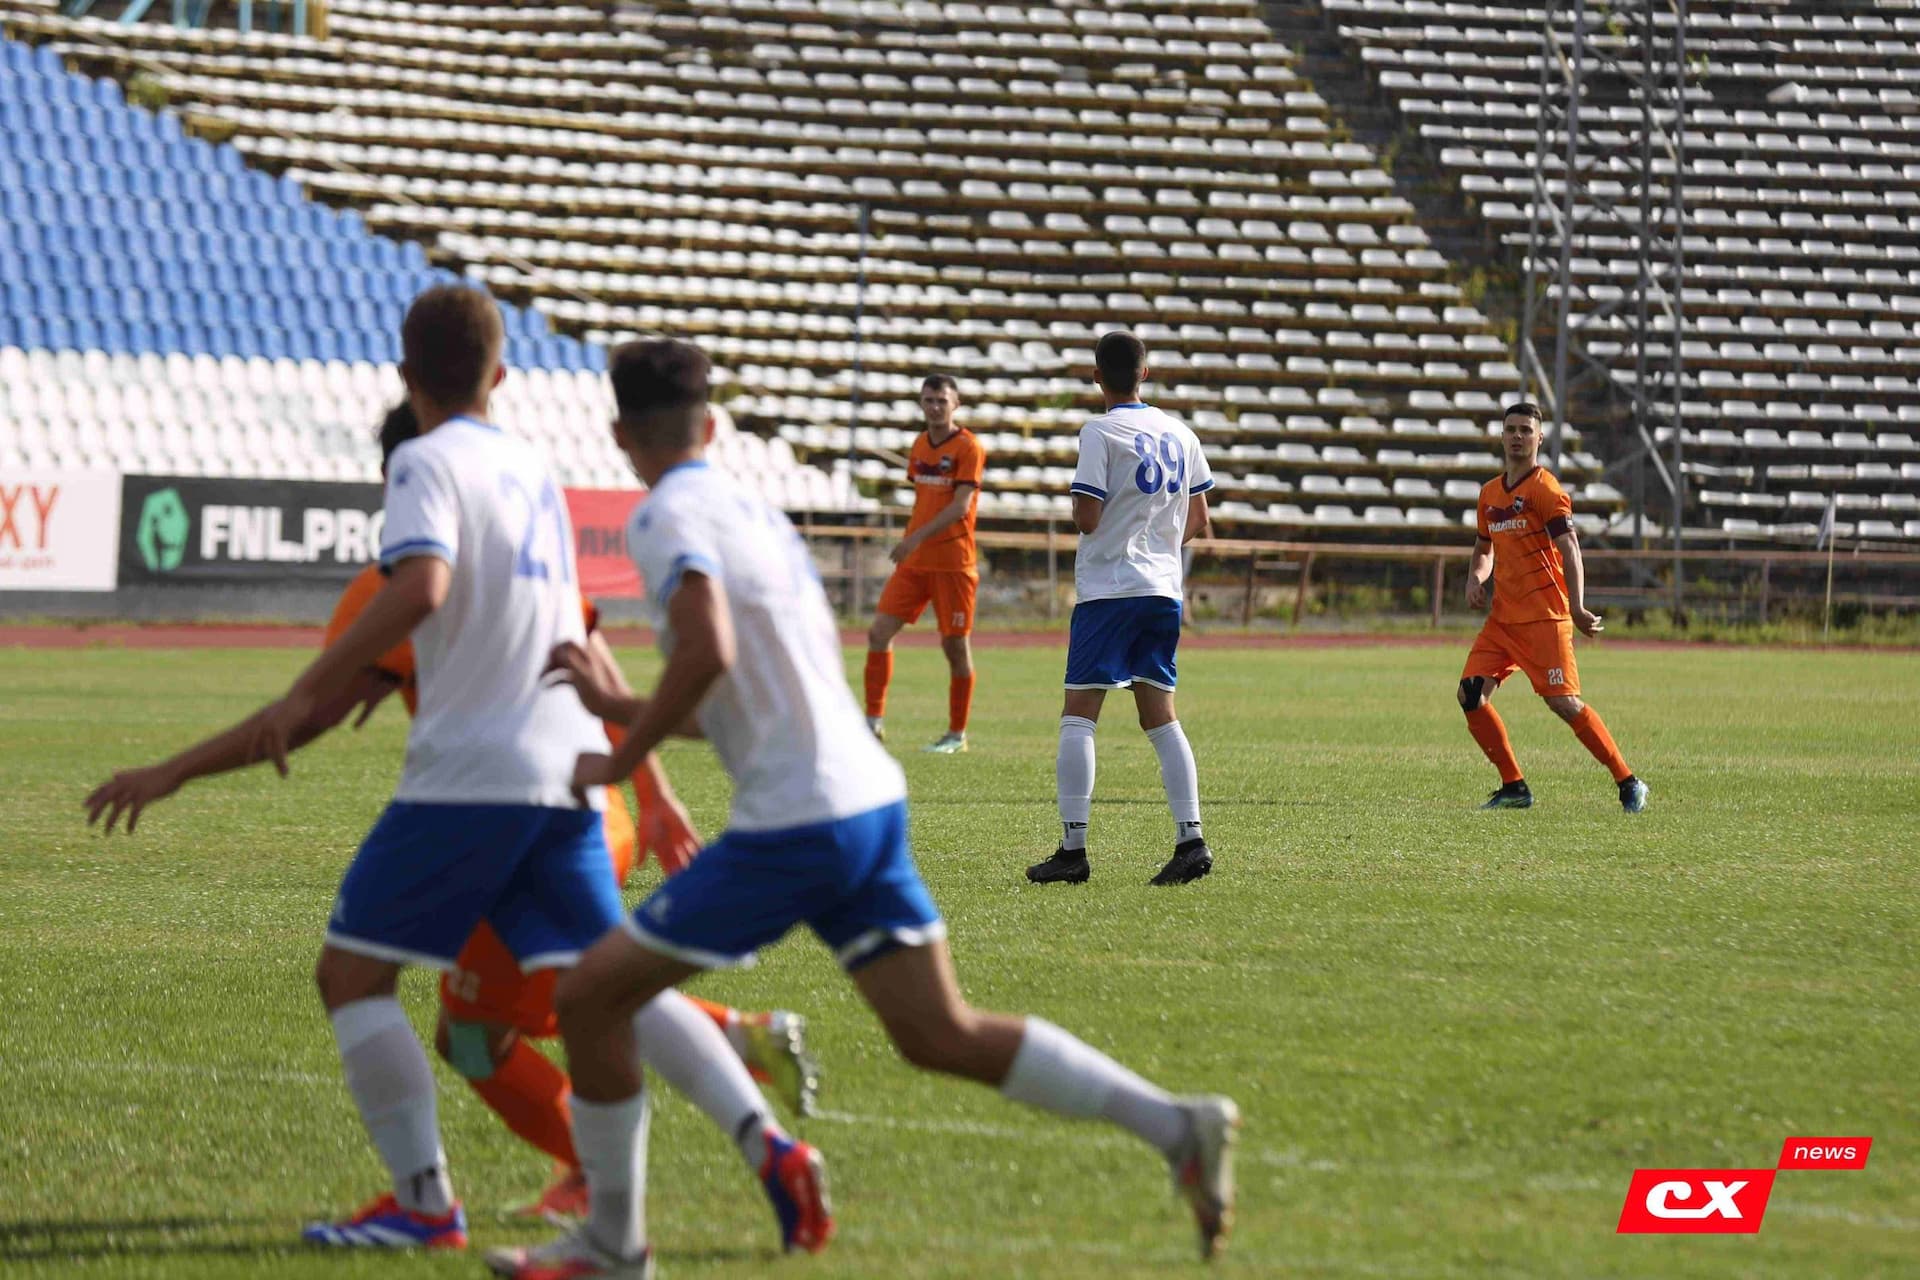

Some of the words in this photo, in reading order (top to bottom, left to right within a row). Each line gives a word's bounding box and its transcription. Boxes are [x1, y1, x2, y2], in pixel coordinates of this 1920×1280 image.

[1134, 432, 1185, 494] 89
[0, 484, 58, 550] XY
[498, 472, 569, 583] 21
[1548, 668, 1564, 686] 23
